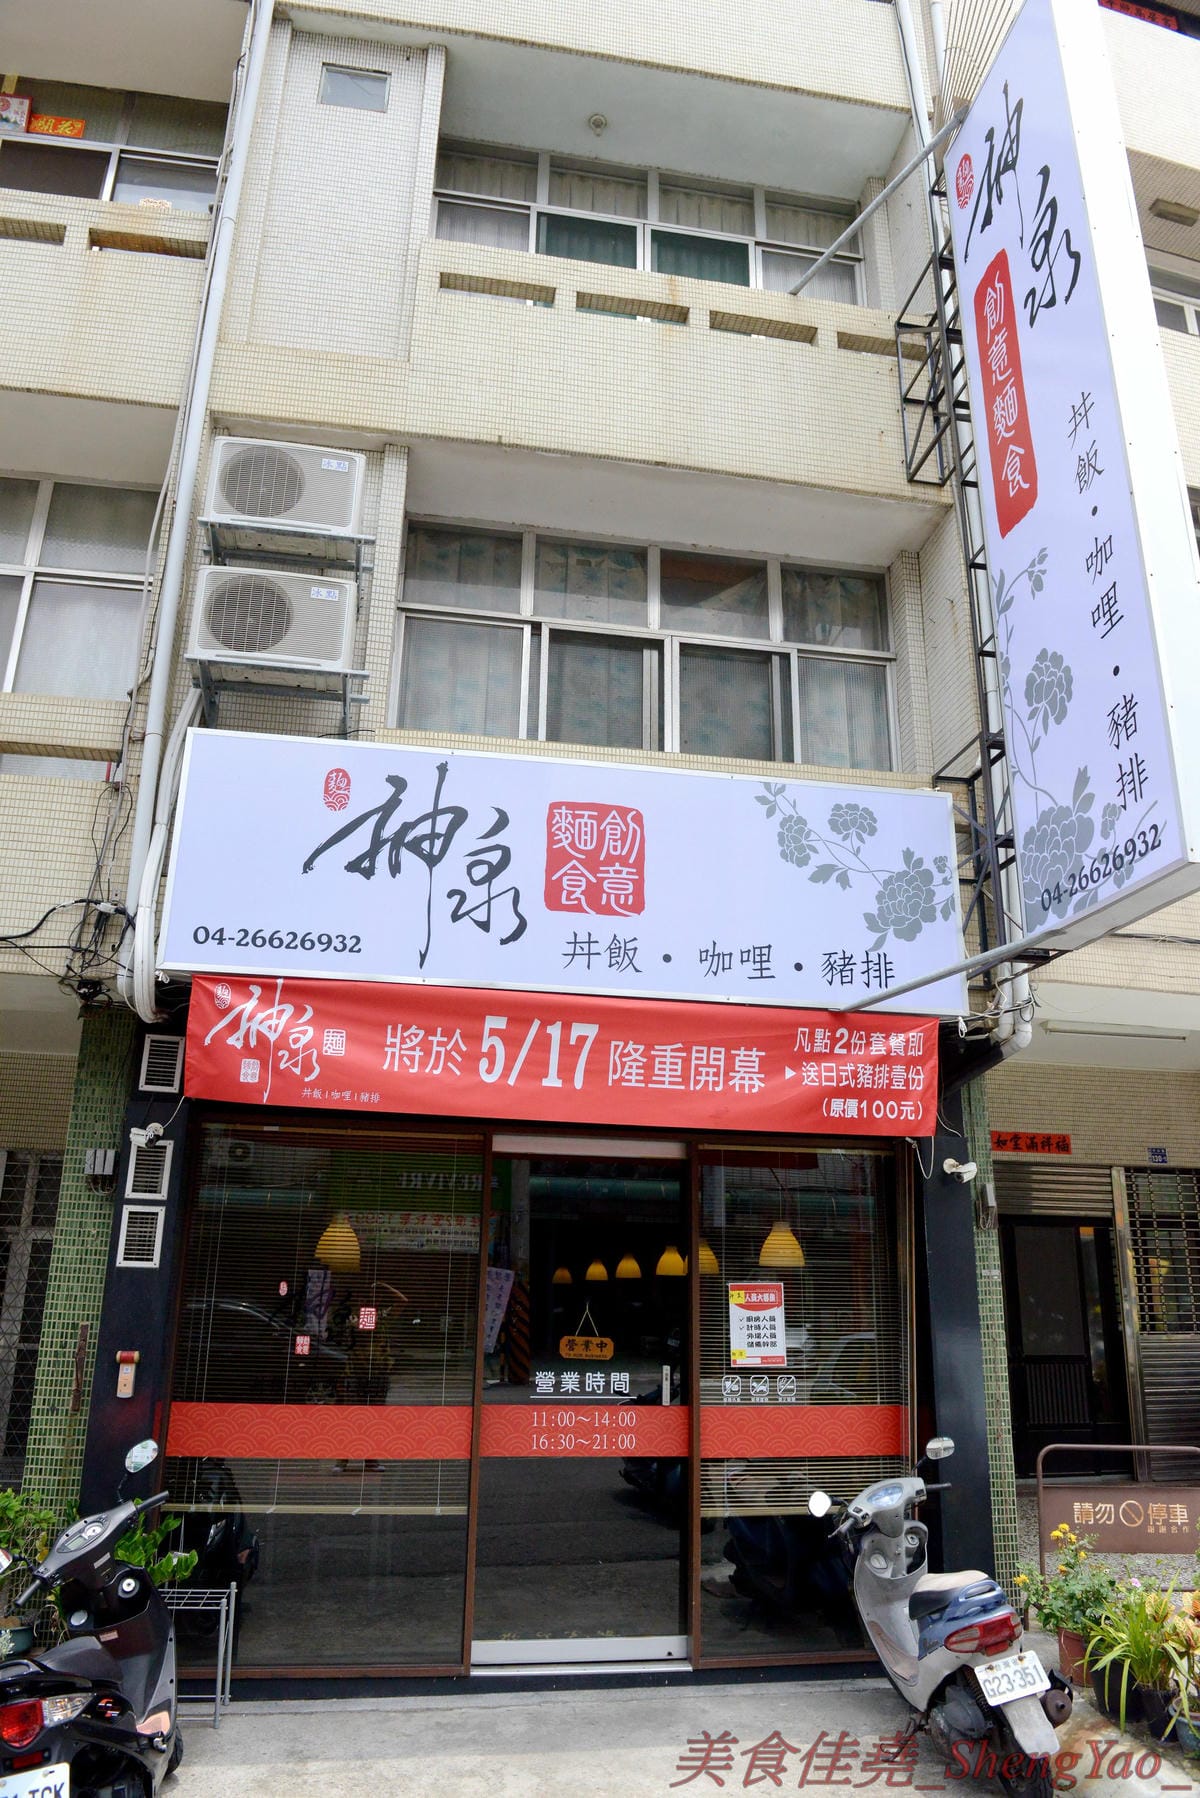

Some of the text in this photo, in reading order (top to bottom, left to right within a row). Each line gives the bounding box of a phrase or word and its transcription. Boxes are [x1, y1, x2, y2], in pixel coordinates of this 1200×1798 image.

[983, 270, 1030, 498] 創意麵食
[1085, 534, 1125, 640] 咖哩
[1106, 693, 1149, 811] 豬排
[1040, 823, 1162, 912] 04-26626932
[192, 926, 362, 954] 04-26626932
[699, 940, 776, 980] 咖哩
[820, 949, 896, 990] 豬排
[382, 1015, 766, 1094] 將於 5/17 隆重開幕
[794, 1027, 924, 1057] 凡點2份套餐即
[802, 1061, 926, 1091] 送日式豬排壹份
[535, 1371, 630, 1394] 營業時間
[1073, 1502, 1189, 1525] 請勿 停車
